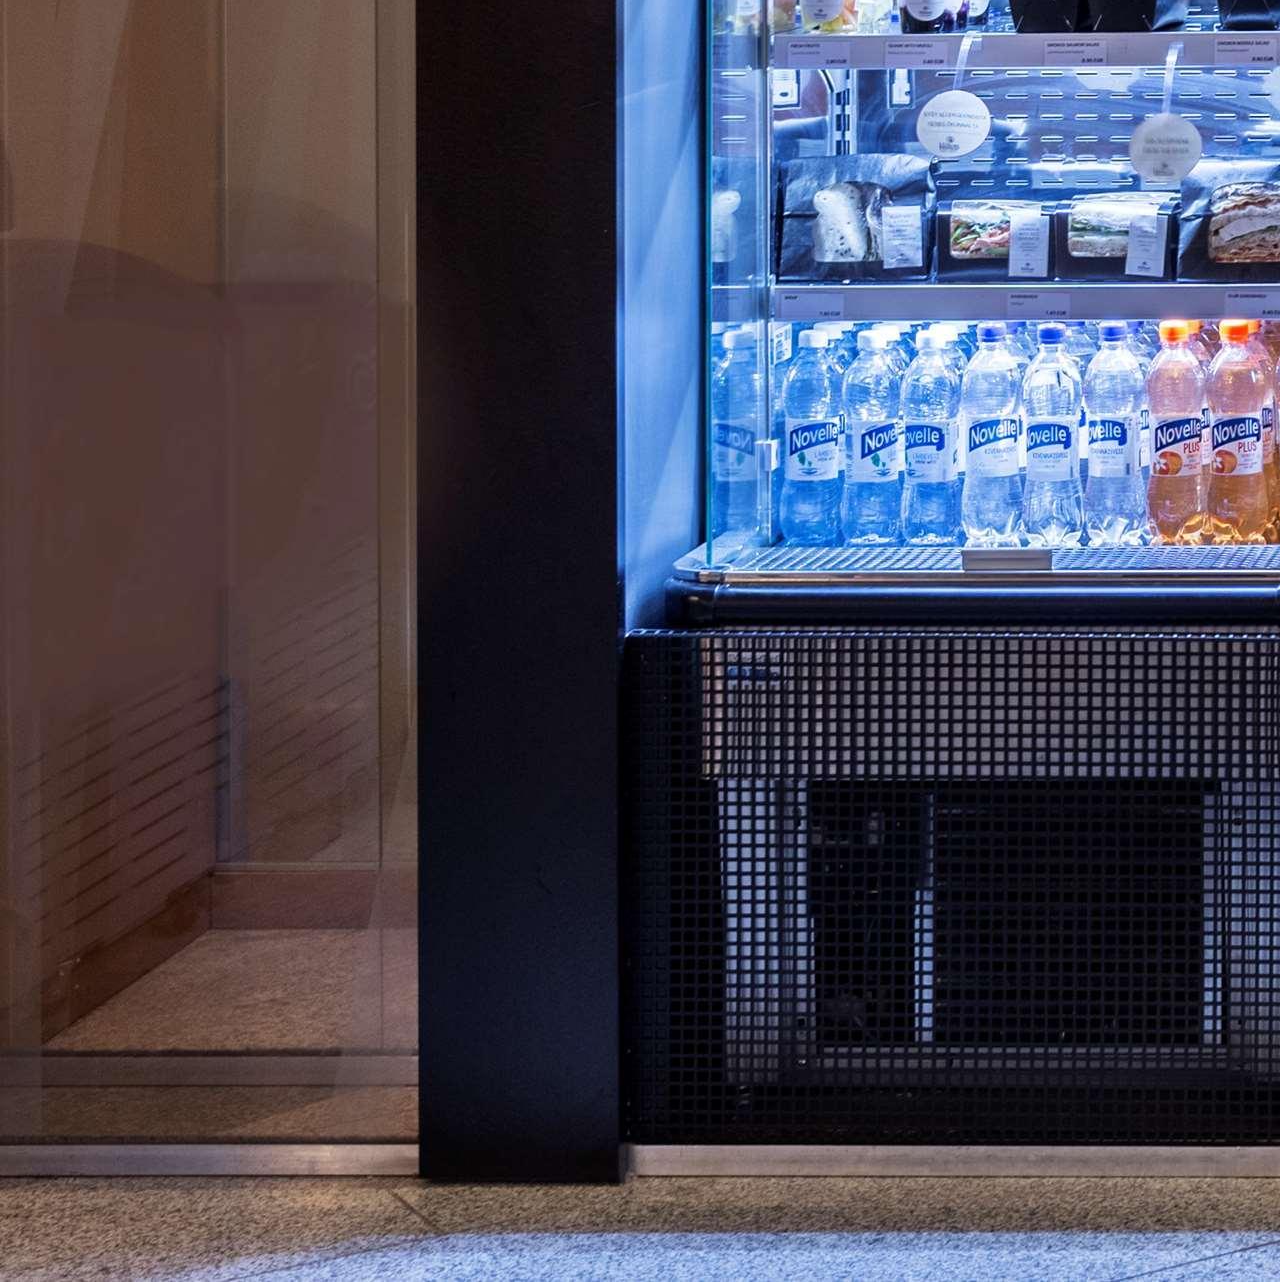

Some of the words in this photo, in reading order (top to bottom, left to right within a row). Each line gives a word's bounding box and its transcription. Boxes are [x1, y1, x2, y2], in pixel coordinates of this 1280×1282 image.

[791, 424, 839, 449] Novelle
[863, 423, 898, 452] Nove
[970, 420, 1017, 444] Novelle
[1156, 421, 1201, 448] Novelle
[1213, 419, 1260, 445] Novelle
[1183, 441, 1201, 453] PLUS
[1237, 440, 1257, 453] PLUS
